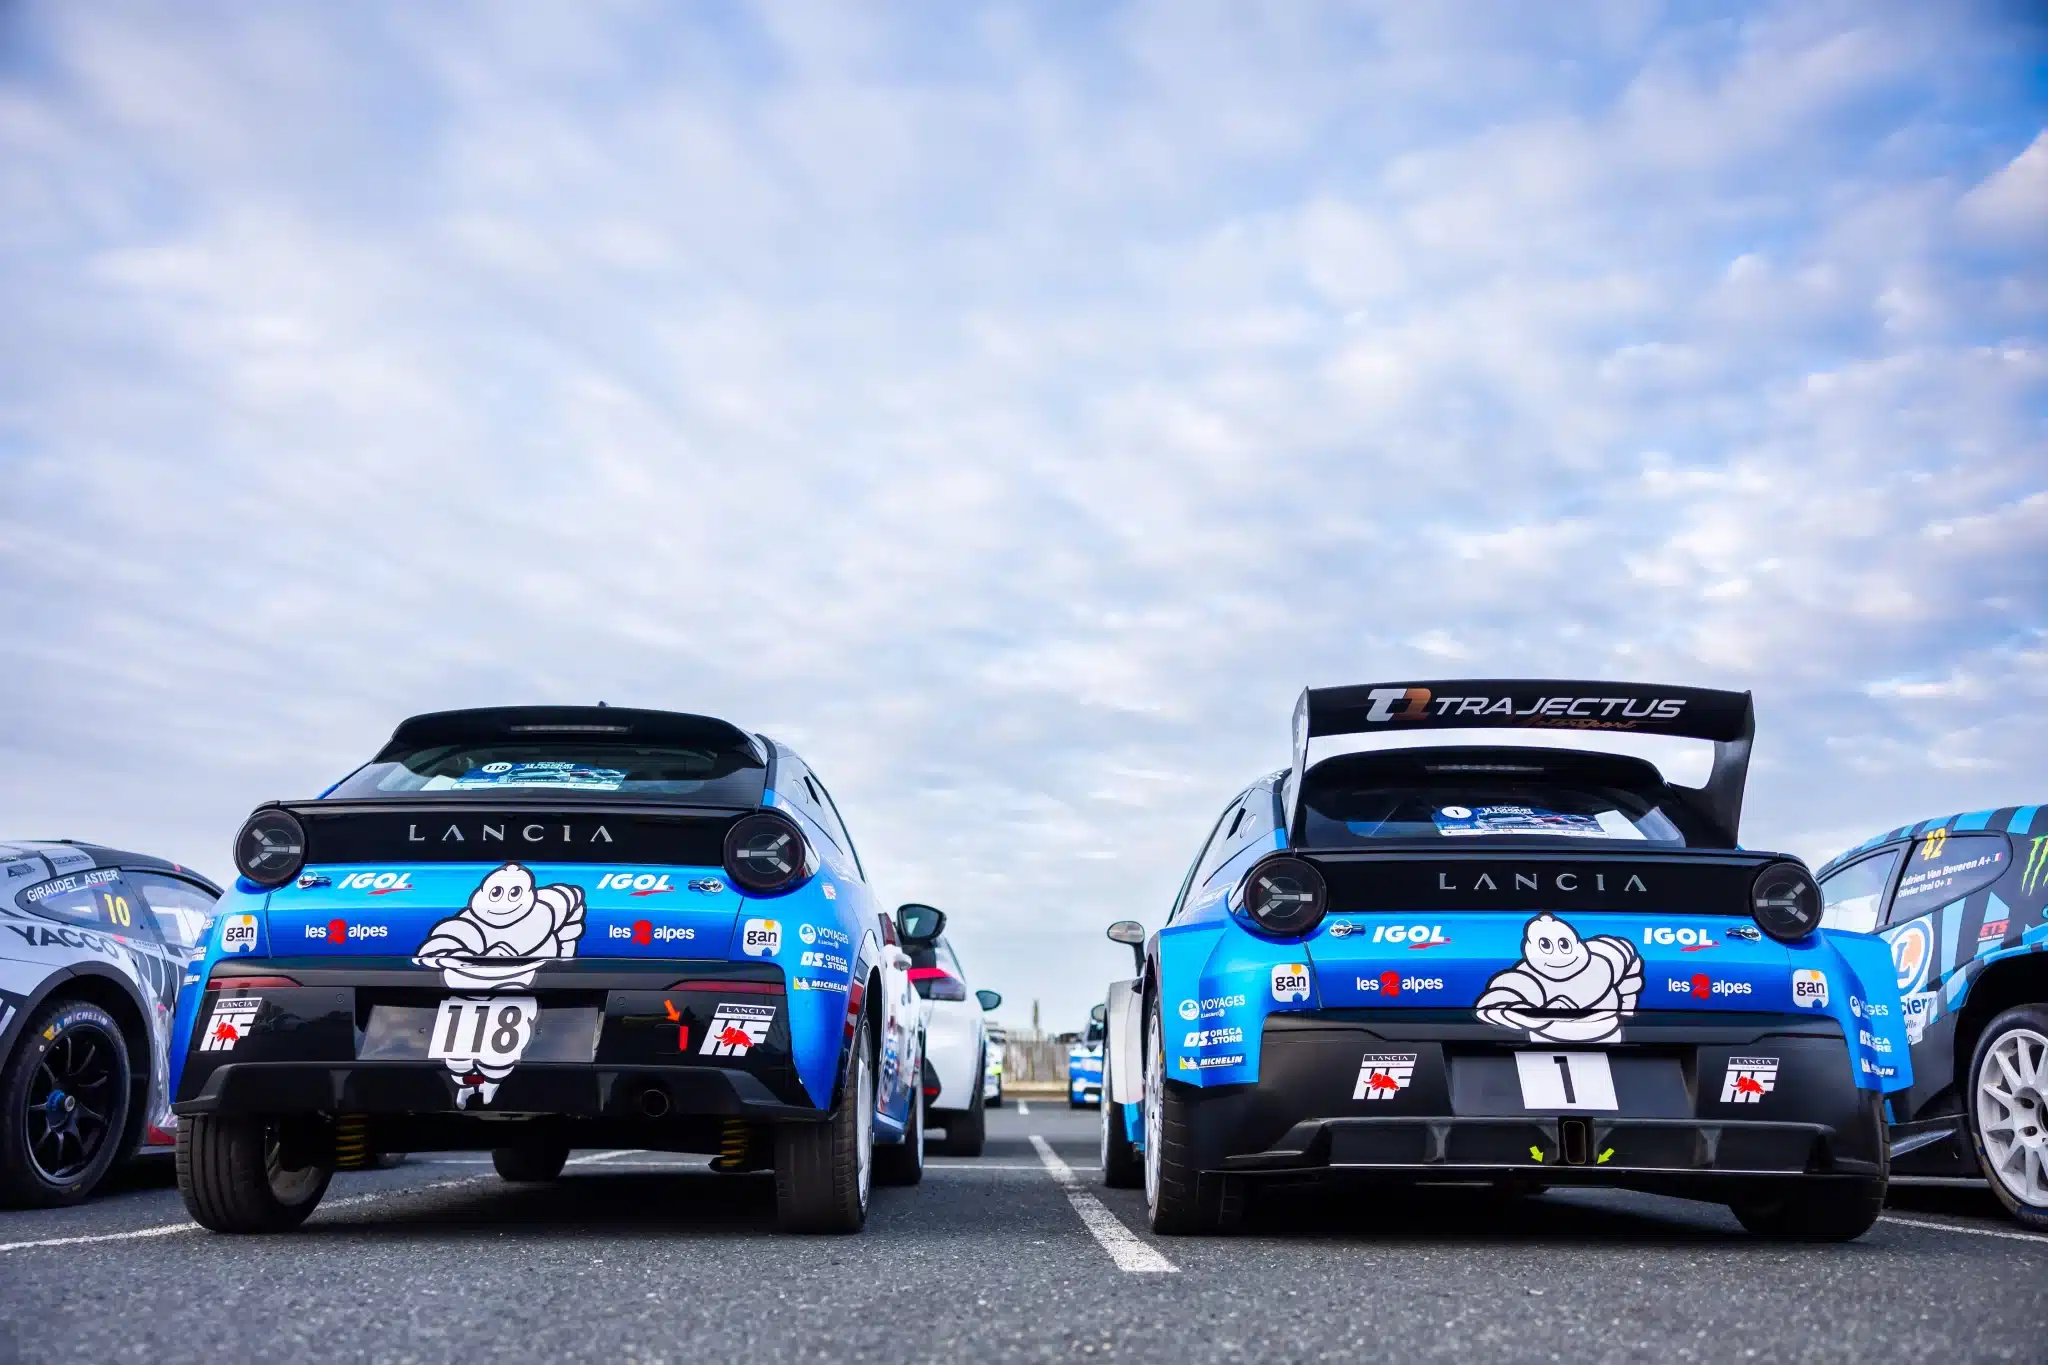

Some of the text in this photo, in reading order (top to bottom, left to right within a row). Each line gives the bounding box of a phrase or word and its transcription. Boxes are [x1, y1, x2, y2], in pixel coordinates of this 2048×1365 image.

[1435, 696, 1687, 718] TRAJECTUS
[408, 824, 613, 842] LANCIA
[1921, 828, 1946, 861] 42
[27, 869, 120, 902] GIRAUDET ASTIER
[338, 872, 412, 889] IGOL
[597, 873, 673, 890] IGOL
[1439, 873, 1647, 892] LANCIA
[1900, 873, 1926, 887] Adrien
[104, 893, 130, 927] 10
[226, 926, 255, 941] gan
[305, 918, 388, 944] les 2 alpes
[609, 919, 695, 945] les 2 alpes
[817, 926, 849, 945] VOYAGES
[1372, 925, 1448, 943] IGOL
[1643, 927, 1715, 946] IGOL
[1980, 920, 2009, 937] ETS
[4, 925, 119, 960] YACCO
[747, 930, 778, 945] gan
[825, 954, 848, 966] ORECA
[828, 961, 849, 973] STORE
[812, 979, 848, 991] MICHELIN
[1275, 976, 1306, 991] gan
[1356, 970, 1444, 997] les 2 alpes
[1668, 973, 1752, 999] les 2 alpes
[1796, 981, 1825, 996] gan
[1200, 994, 1245, 1011] VOYAGES
[64, 1011, 108, 1026] MICHELIN
[443, 1005, 522, 1054] 118
[1210, 1026, 1243, 1037] ORECA
[1212, 1034, 1243, 1045] STORE
[1200, 1055, 1243, 1066] MICHELIN
[1554, 1055, 1576, 1104] 1
